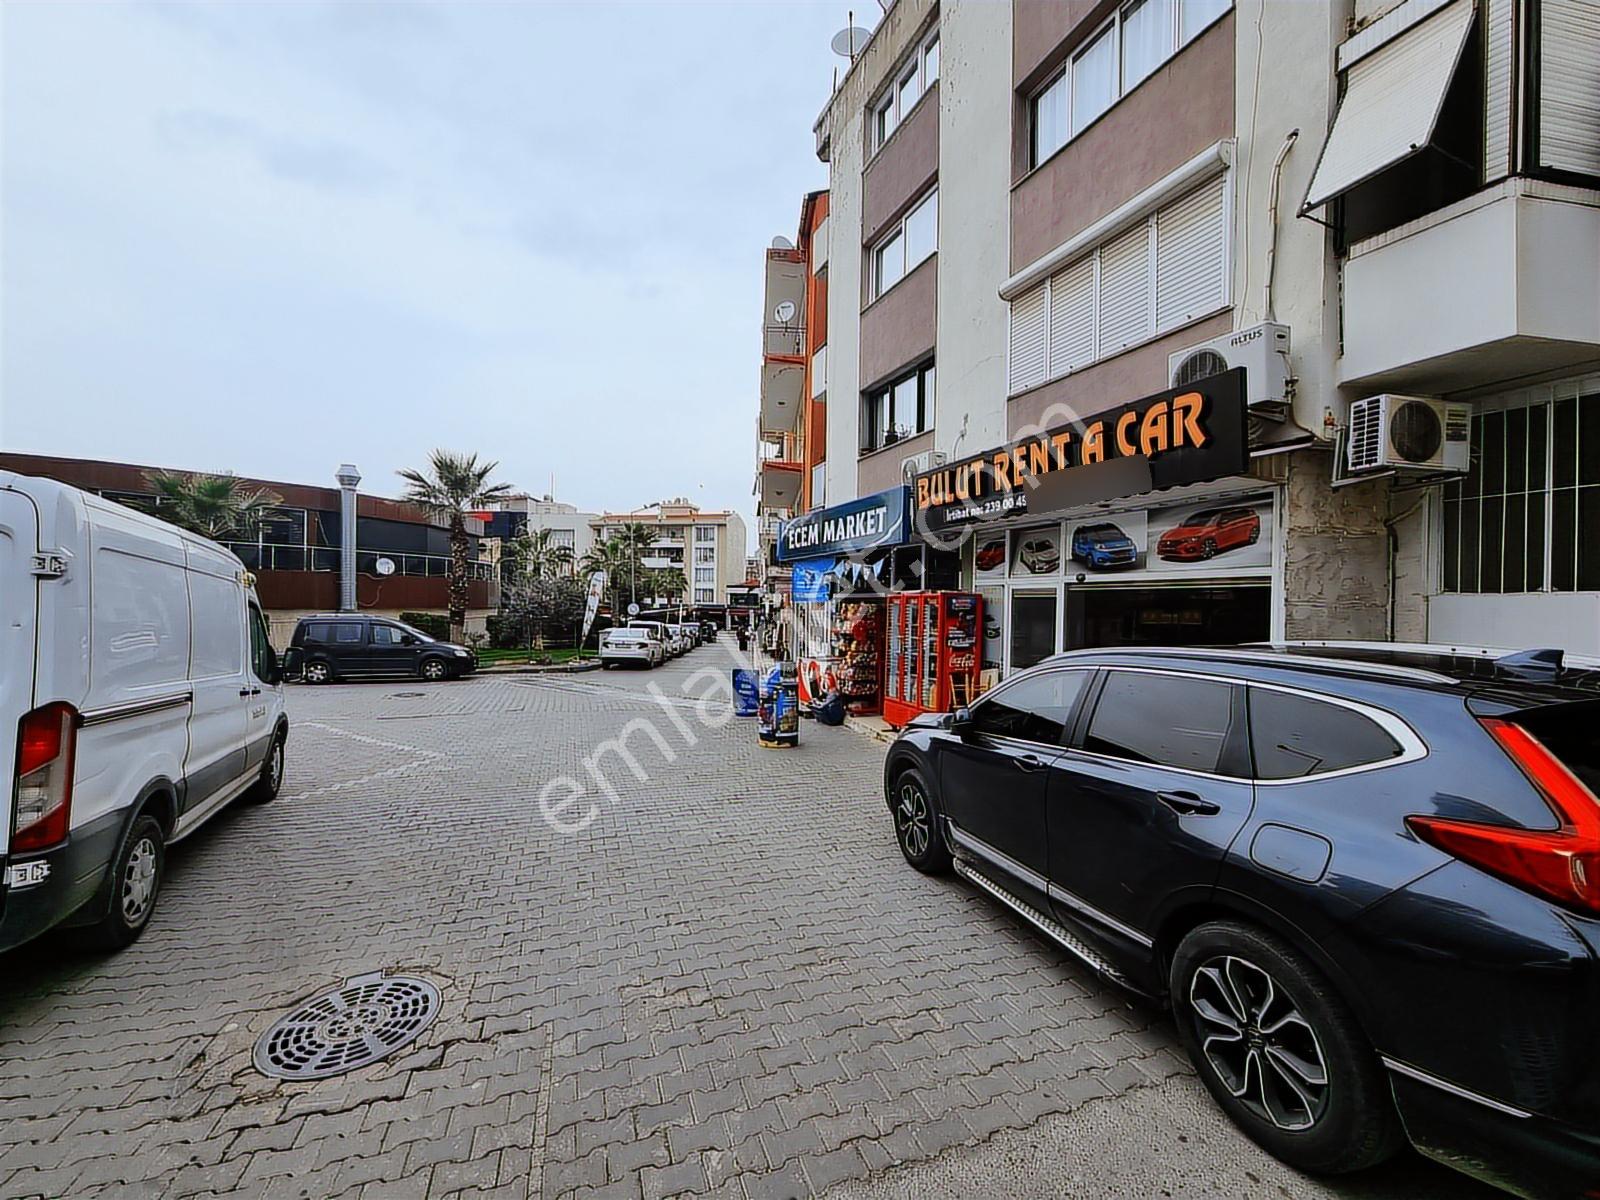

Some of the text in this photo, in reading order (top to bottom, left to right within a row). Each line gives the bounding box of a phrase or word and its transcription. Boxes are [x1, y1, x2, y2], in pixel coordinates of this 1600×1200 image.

[1231, 328, 1264, 347] ALTUS
[917, 391, 1206, 510] BULUT RENT A CAR
[984, 500, 1001, 514] 239
[1002, 497, 1015, 509] 00
[1015, 494, 1028, 507] 45
[788, 505, 888, 550] ECEM MARKET
